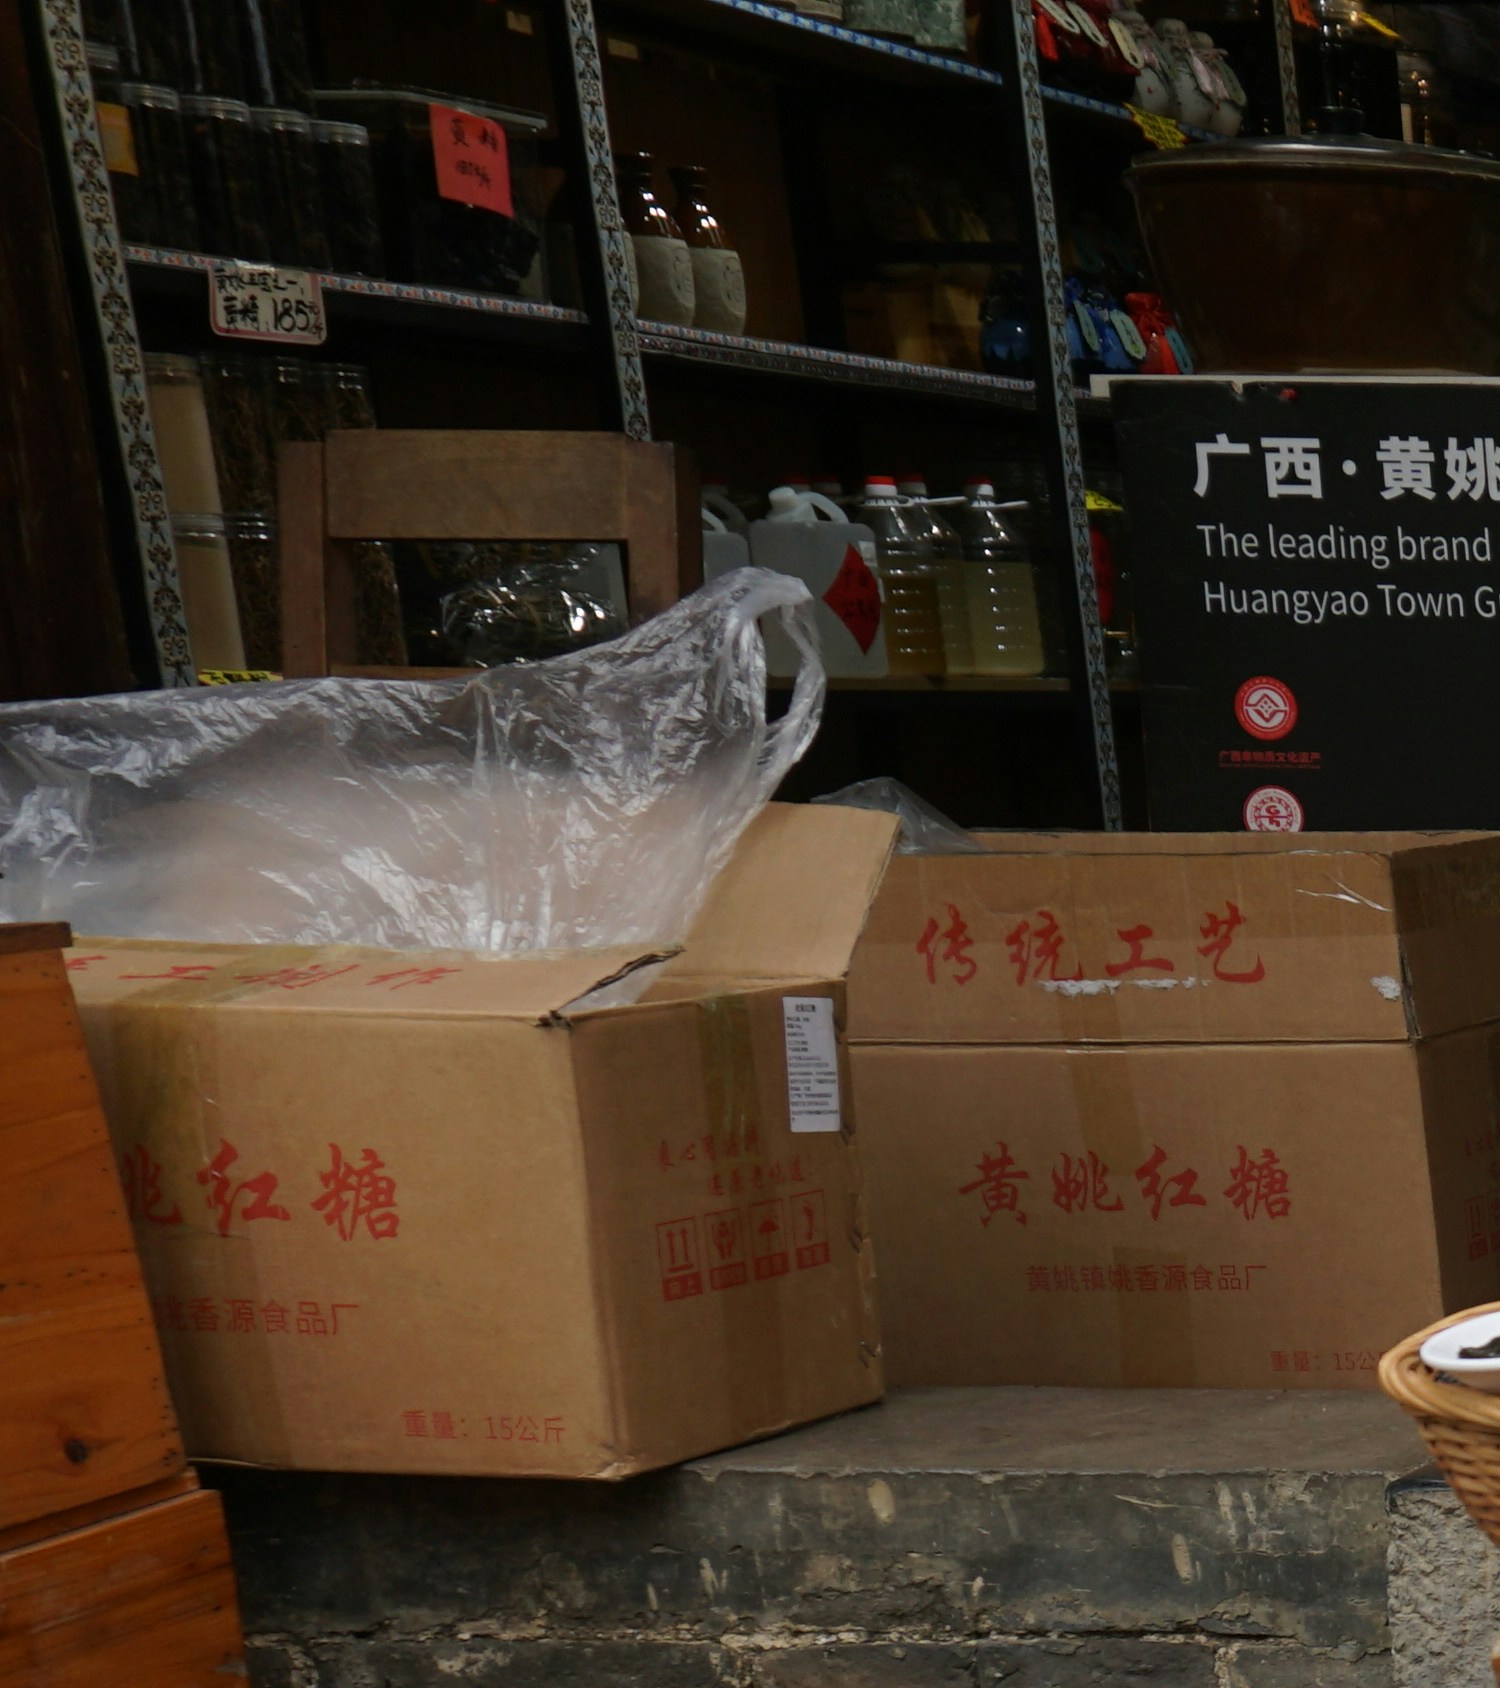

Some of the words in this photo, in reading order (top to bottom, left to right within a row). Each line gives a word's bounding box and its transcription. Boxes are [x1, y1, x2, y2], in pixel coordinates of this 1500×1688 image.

[1197, 524, 1259, 560] The
[1270, 525, 1390, 568] leading
[1398, 527, 1492, 564] brand
[1203, 581, 1370, 624] Huangyao
[1376, 583, 1465, 620] Town
[915, 901, 1267, 988] 传统工艺
[958, 1142, 1294, 1228] 黄姚红糖
[1025, 1263, 1268, 1294] 黄姚镇姚香源食品厂
